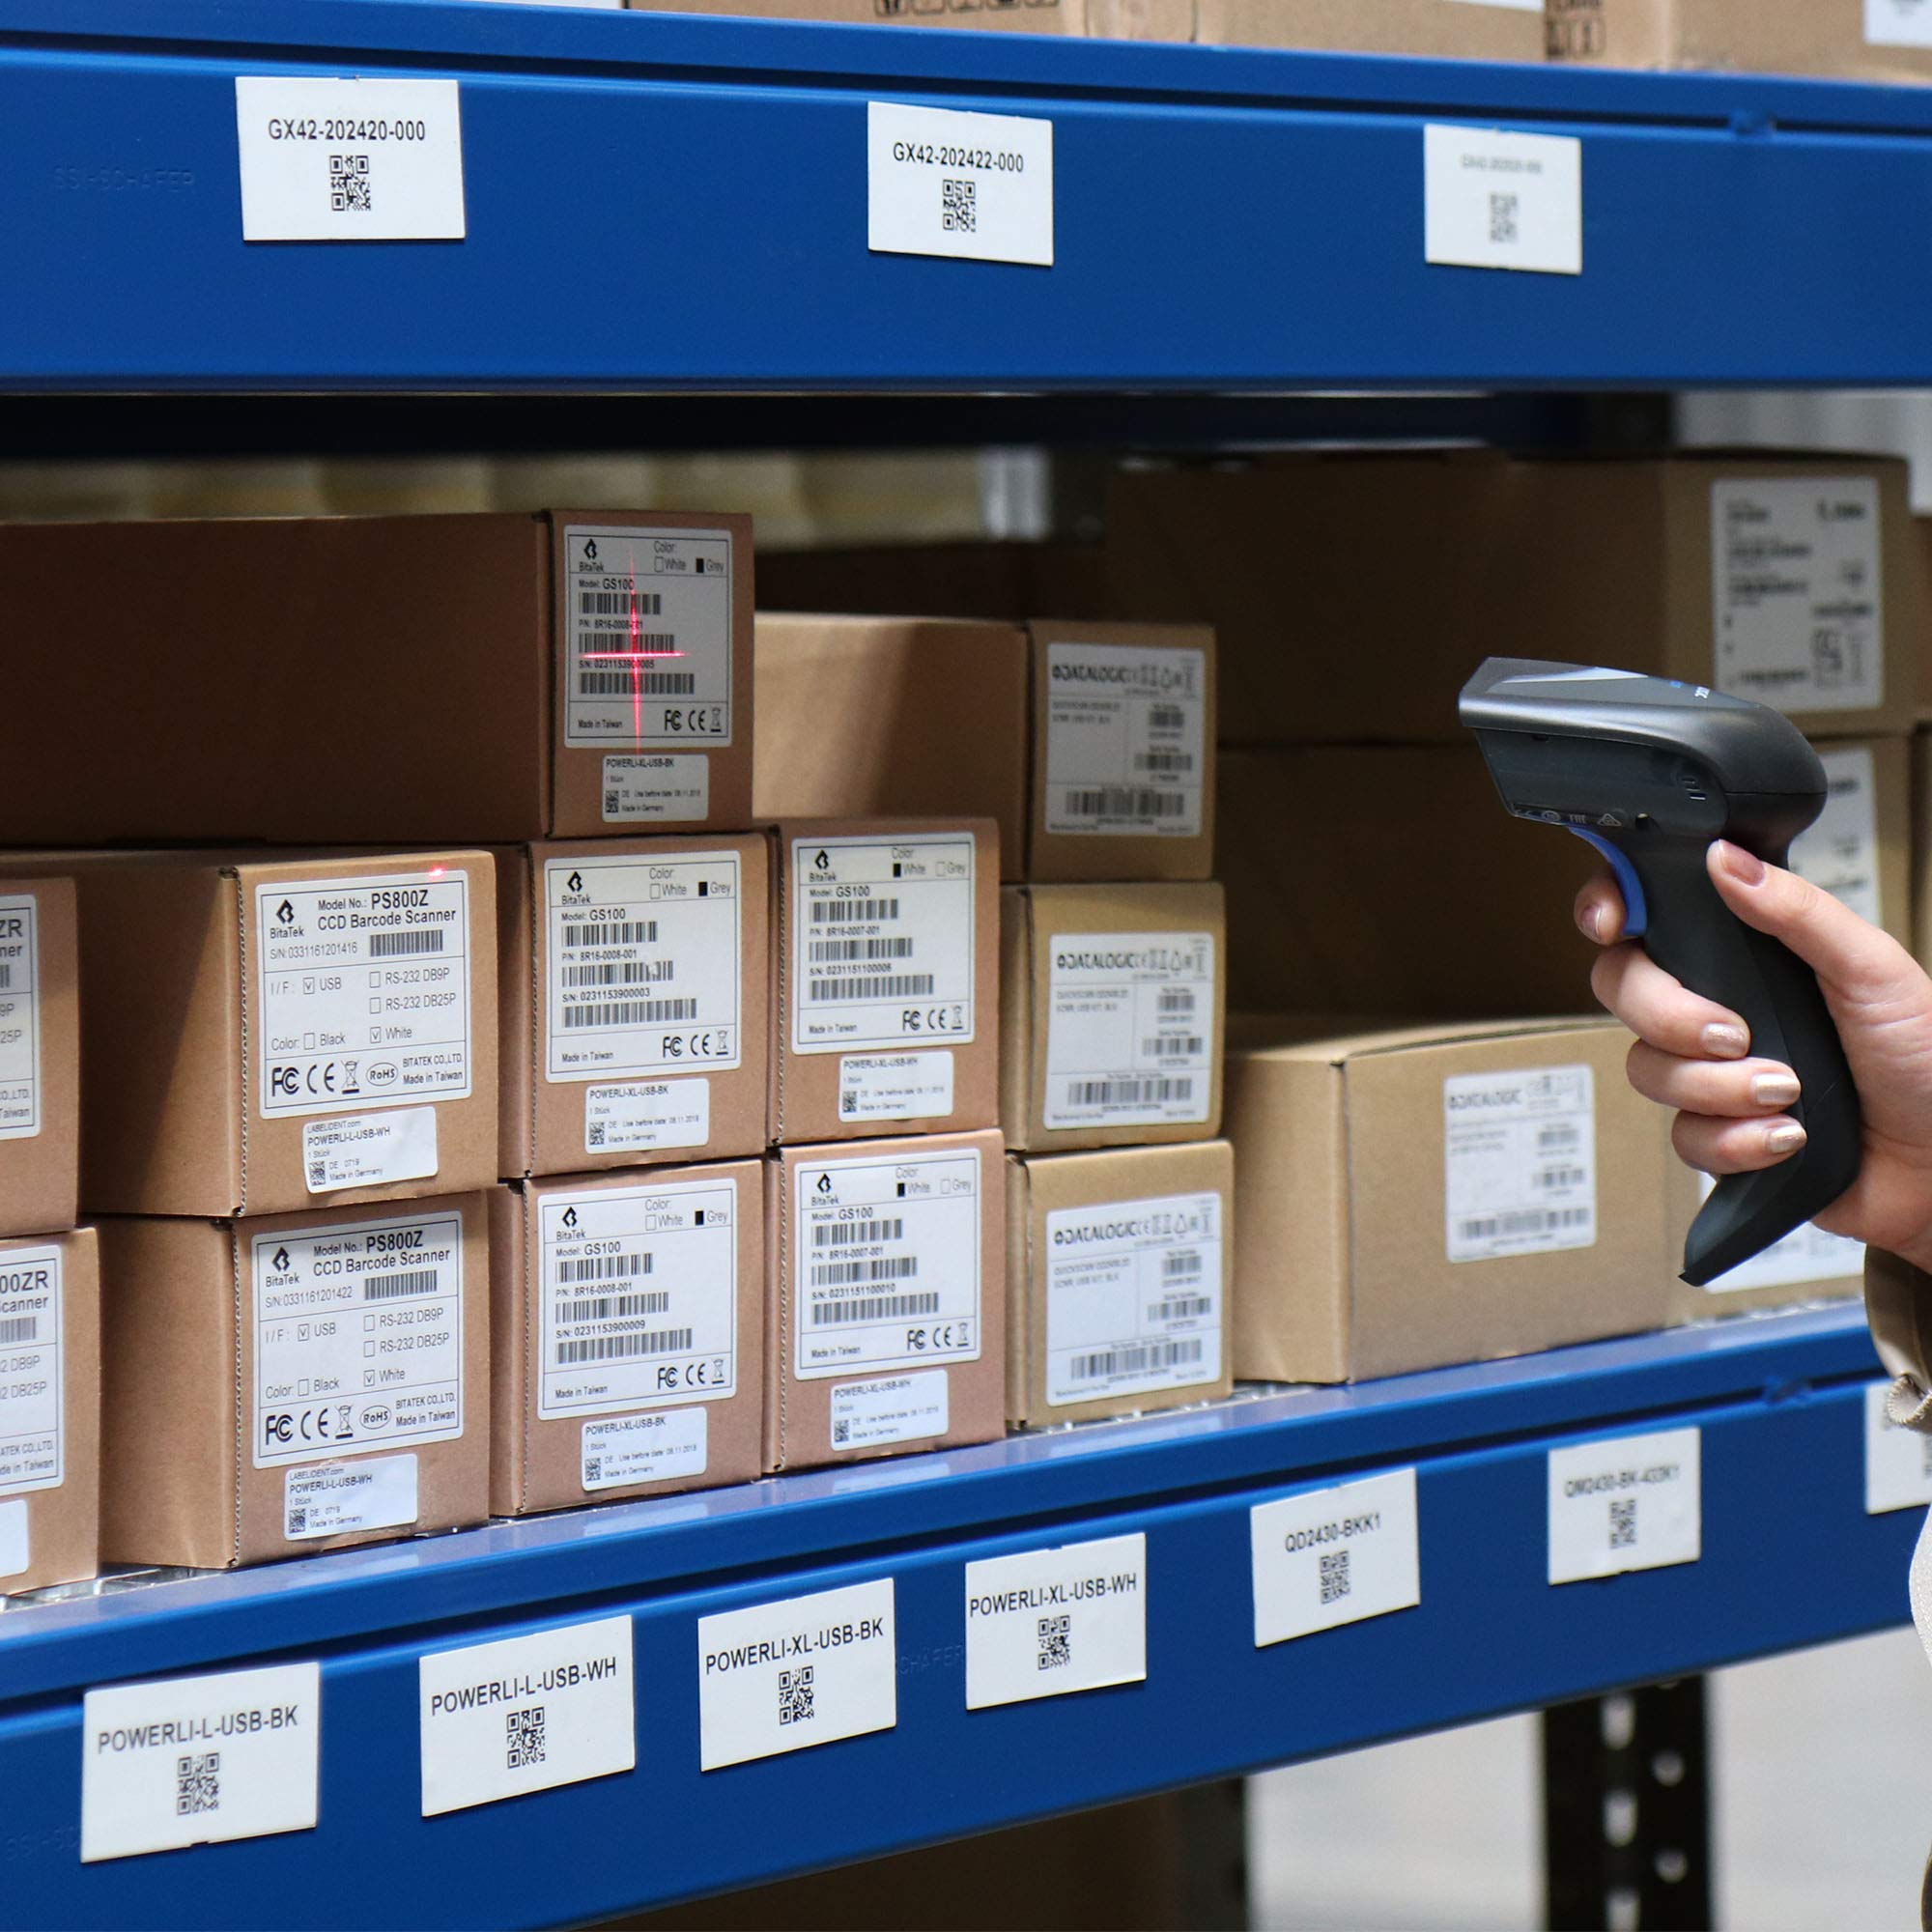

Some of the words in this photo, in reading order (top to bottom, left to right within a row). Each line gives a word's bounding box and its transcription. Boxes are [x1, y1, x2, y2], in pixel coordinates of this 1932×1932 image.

[268, 118, 426, 142] GX42-202420-000
[893, 141, 1024, 175] GX42-202422-000
[663, 884, 687, 896] White
[711, 882, 731, 896] Grey
[837, 886, 869, 897] GS100
[319, 898, 343, 911] Model
[371, 890, 428, 910] PS800Z
[561, 895, 591, 905] BitaTek
[318, 914, 347, 930] CCD
[351, 910, 401, 929] Barcode
[405, 908, 455, 924] Scanner
[589, 909, 625, 920] GS100
[270, 926, 304, 940] BitaTek
[320, 978, 341, 991] USB
[385, 970, 419, 984] RS-232
[423, 968, 450, 981] DB9P
[385, 996, 419, 1011] RS-232
[423, 993, 456, 1008] DB25P
[581, 988, 650, 1001] 0231153900003
[320, 1033, 345, 1046] Black
[385, 1027, 412, 1040] White
[403, 1056, 433, 1067] BITATEK
[562, 1053, 580, 1063] Made
[582, 1052, 588, 1062] in
[590, 1051, 613, 1061] Taiwan
[370, 1067, 395, 1080] RoHS
[404, 1073, 424, 1085] Made
[426, 1072, 433, 1083] in
[435, 1069, 462, 1082] Taiwan
[589, 1086, 668, 1099] POWERLI-XL-USB-BK
[308, 1126, 390, 1147] POWERLI-L-USB-WH
[811, 1196, 839, 1207] BitaTek
[659, 1214, 683, 1228] White
[707, 1210, 727, 1224] Grey
[838, 1208, 873, 1219] GS100
[314, 1245, 341, 1257] Model
[366, 1231, 423, 1253] PS800Z
[556, 1230, 586, 1241] BitaTek
[584, 1241, 621, 1255] GS100
[314, 1260, 341, 1277] CCD
[346, 1256, 395, 1272] Barcode
[400, 1250, 450, 1266] Scanner
[0, 1270, 48, 1293] 00ZR
[266, 1274, 299, 1288] BitaTek
[315, 1322, 336, 1336] USB
[380, 1313, 413, 1327] RS-232
[417, 1308, 443, 1322] DB9P
[575, 1321, 645, 1336] 0231153900009
[380, 1338, 413, 1353] RS-232
[417, 1333, 449, 1349] DB25P
[11, 1354, 40, 1372] DB9P
[11, 1380, 46, 1399] DB25P
[314, 1378, 339, 1392] Black
[380, 1369, 405, 1382] White
[555, 1387, 574, 1399] Made
[576, 1387, 582, 1397] in
[583, 1385, 608, 1396] Taiwan
[396, 1397, 426, 1409] BITATEK
[363, 1410, 387, 1424] RoHS
[396, 1415, 417, 1427] Made
[418, 1413, 426, 1425] in
[428, 1410, 455, 1422] Taiwan
[585, 1416, 667, 1435] POWERLI-XL-USB-BK
[23, 1459, 54, 1471] Taiwan
[290, 1474, 373, 1494] POWERLI-L-USB-WH
[1285, 1512, 1381, 1553] QD2430-BKK1
[969, 1573, 1137, 1619] POWERLI-XL-USB-WH
[705, 1617, 884, 1675] POWERLI-XL-USB-BK
[431, 1657, 618, 1717] POWERLI-L-USB-WH
[98, 1704, 298, 1755] POWERLI-L-USB-BK
